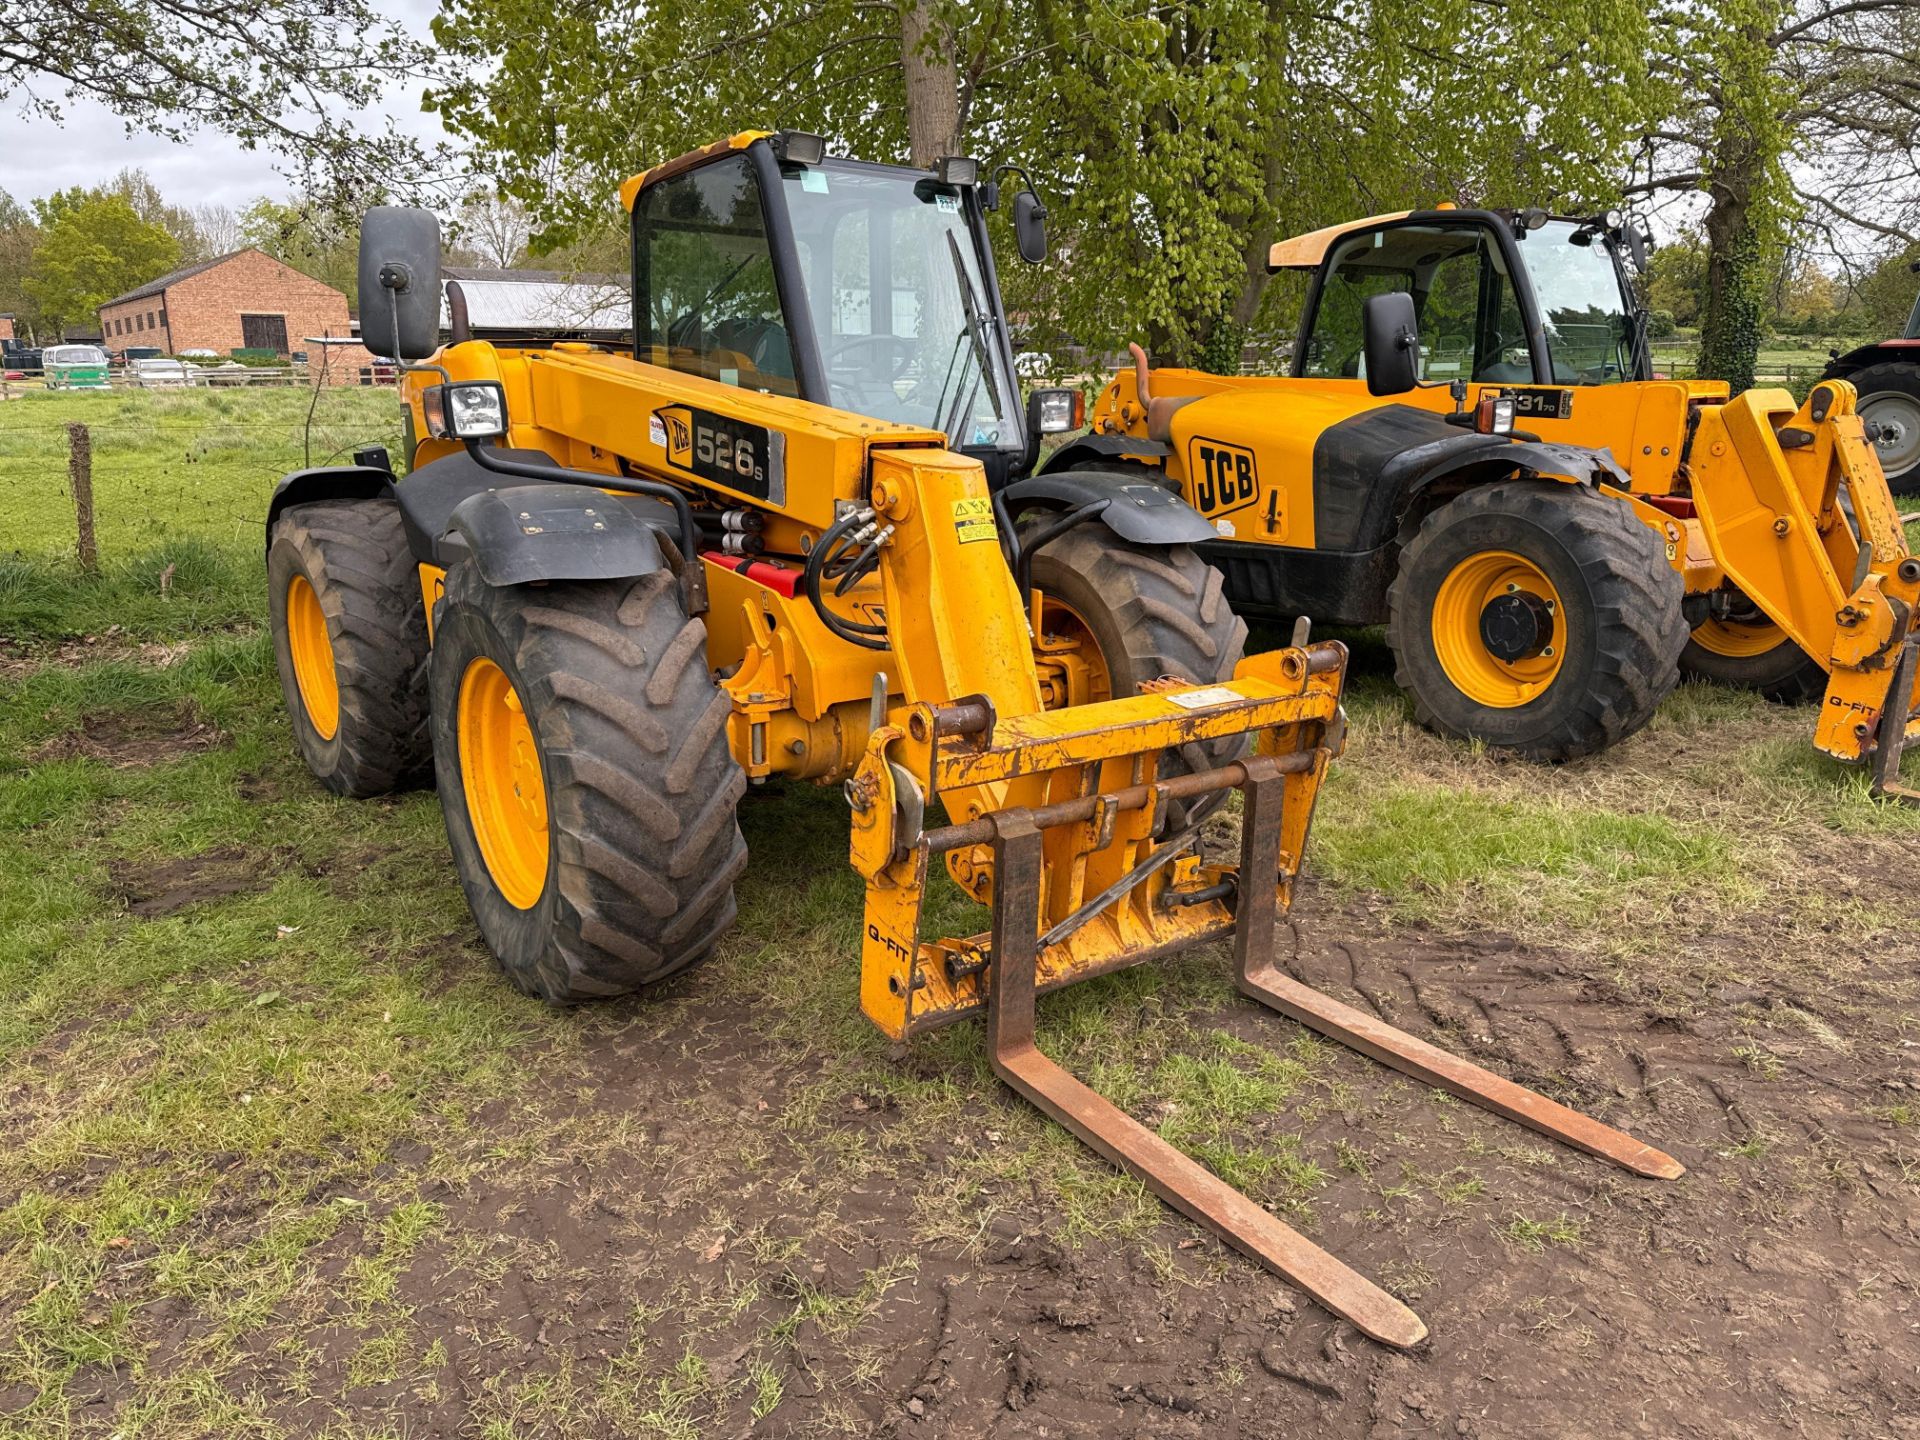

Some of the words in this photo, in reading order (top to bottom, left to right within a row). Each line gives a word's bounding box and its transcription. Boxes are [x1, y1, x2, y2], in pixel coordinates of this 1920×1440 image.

[672, 419, 689, 450] JCB
[1198, 446, 1253, 513] JCB
[1829, 695, 1876, 716] Q-FIT
[868, 923, 909, 963] Q-FIT
